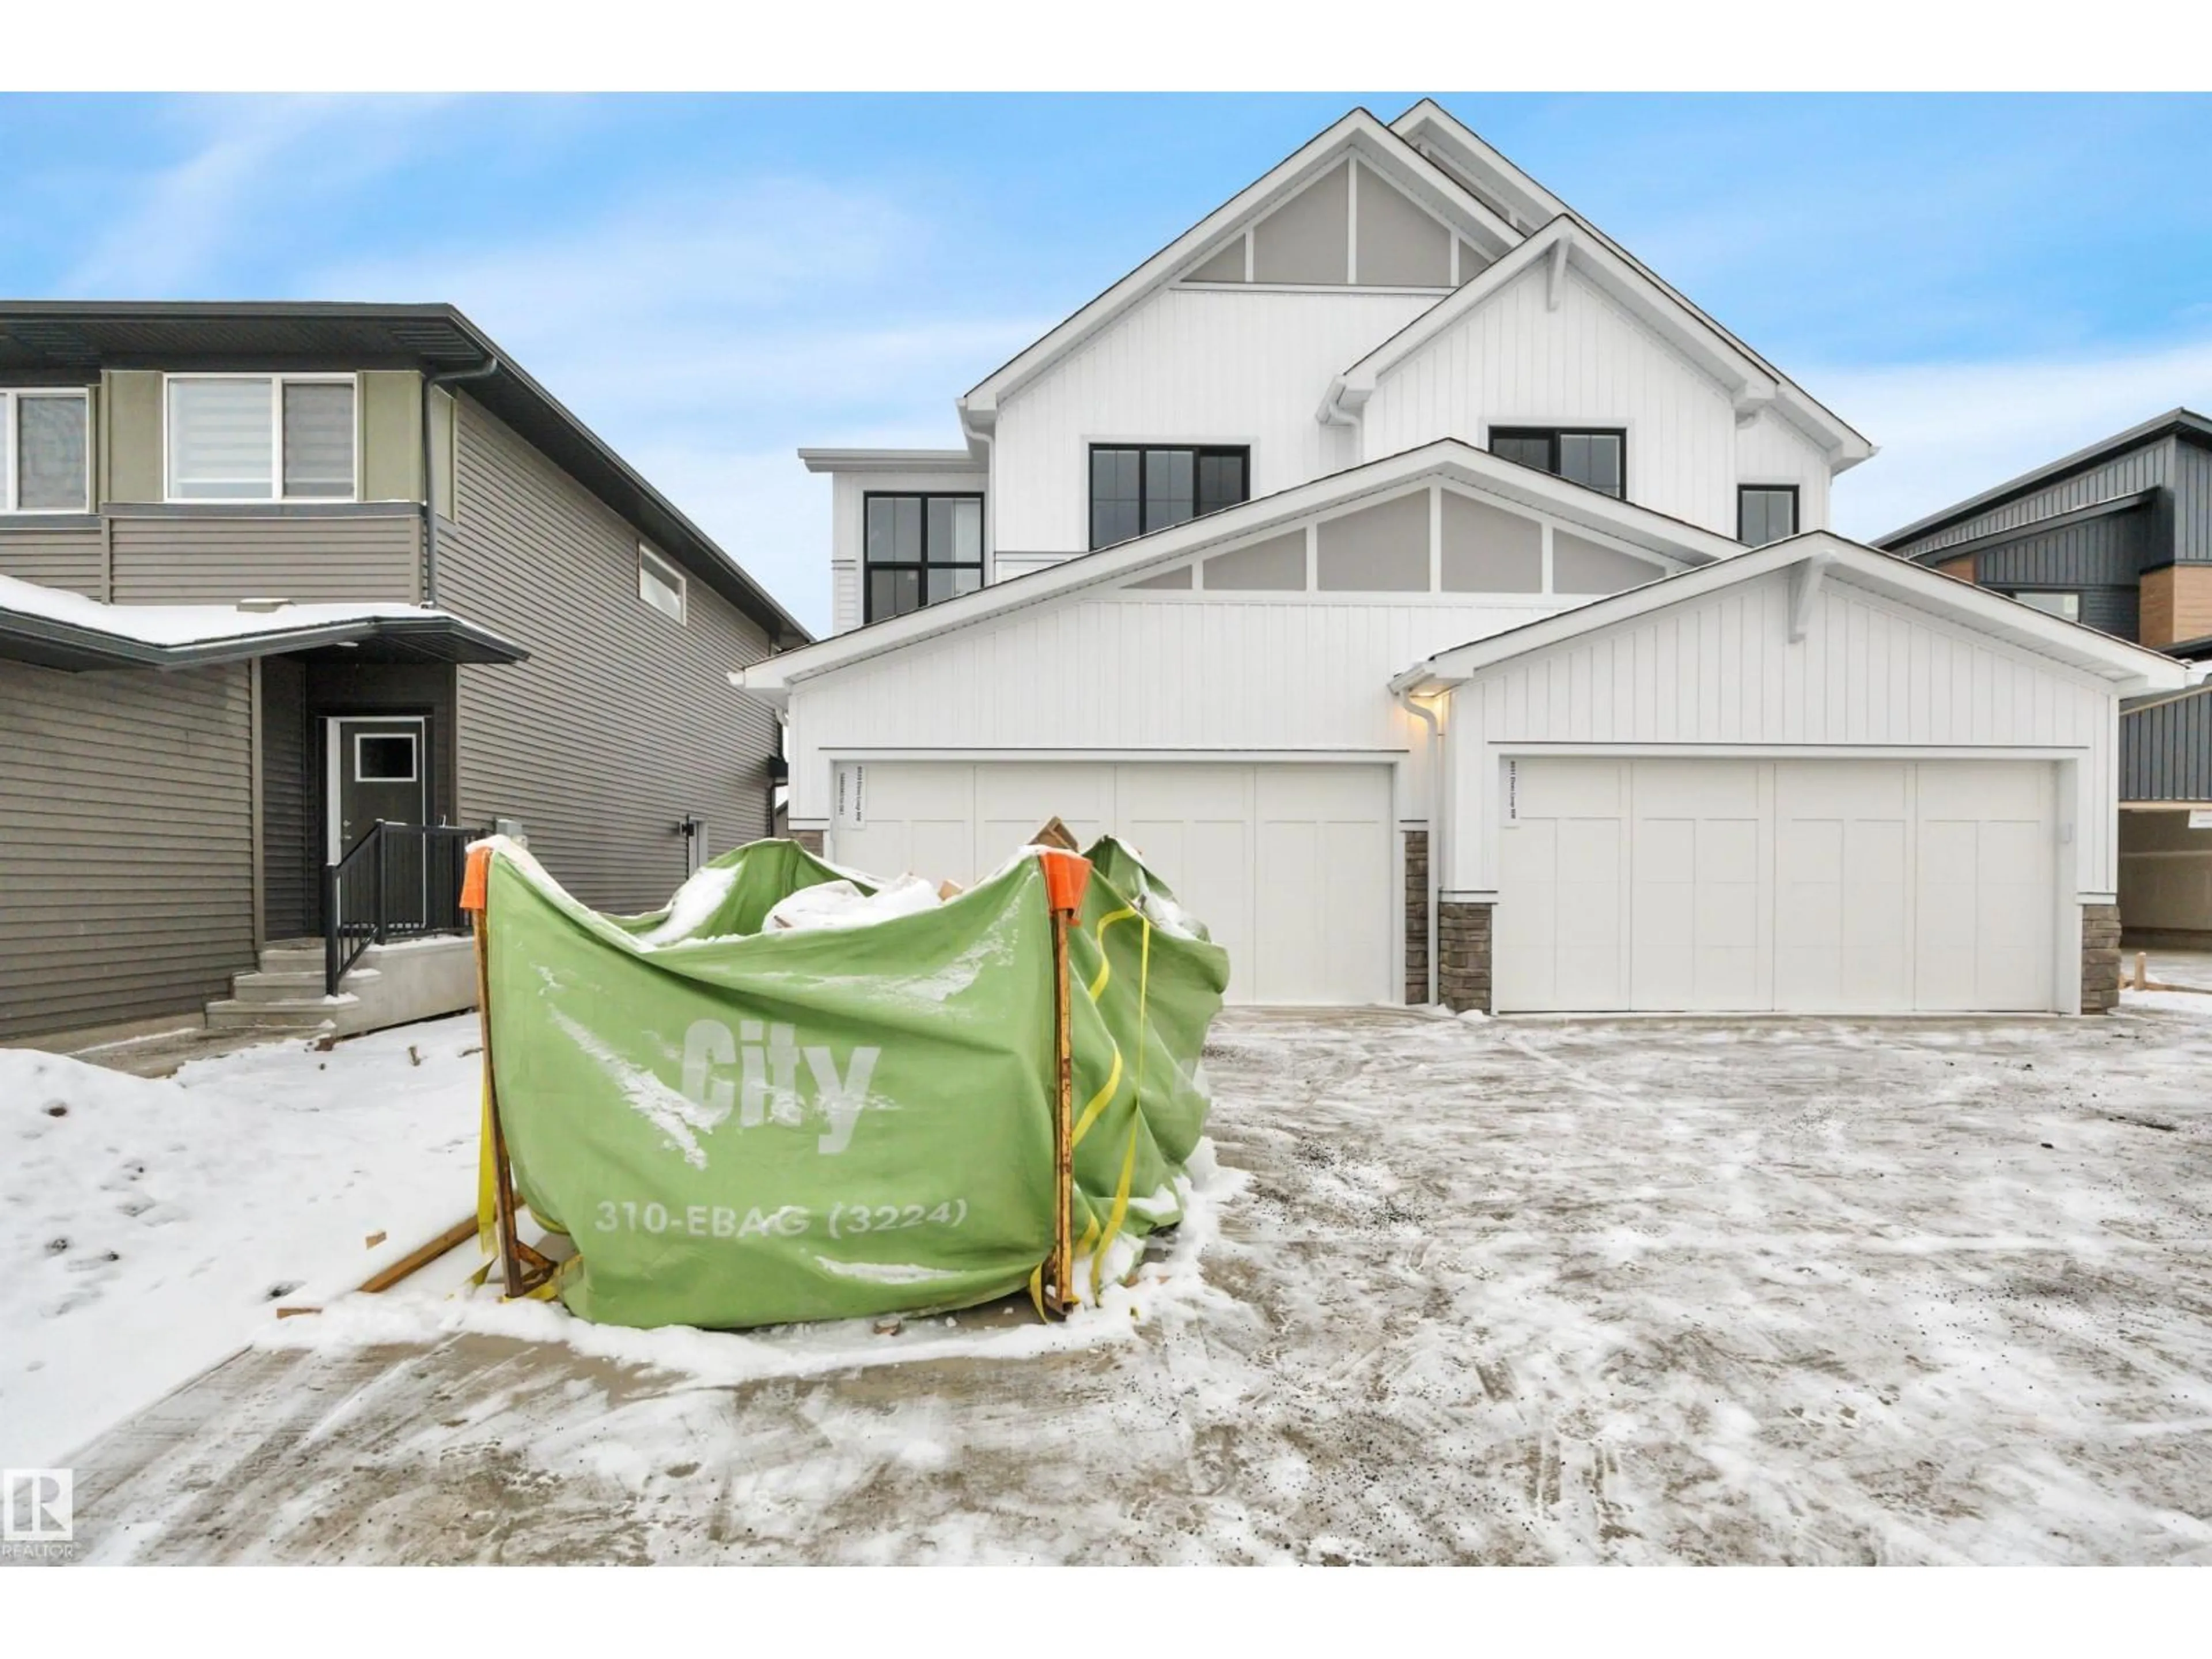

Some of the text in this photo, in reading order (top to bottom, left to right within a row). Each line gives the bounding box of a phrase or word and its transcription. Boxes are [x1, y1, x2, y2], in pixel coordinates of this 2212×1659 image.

[682, 1018, 881, 1154] City
[594, 1198, 968, 1240] 310-EBAG (3224)
